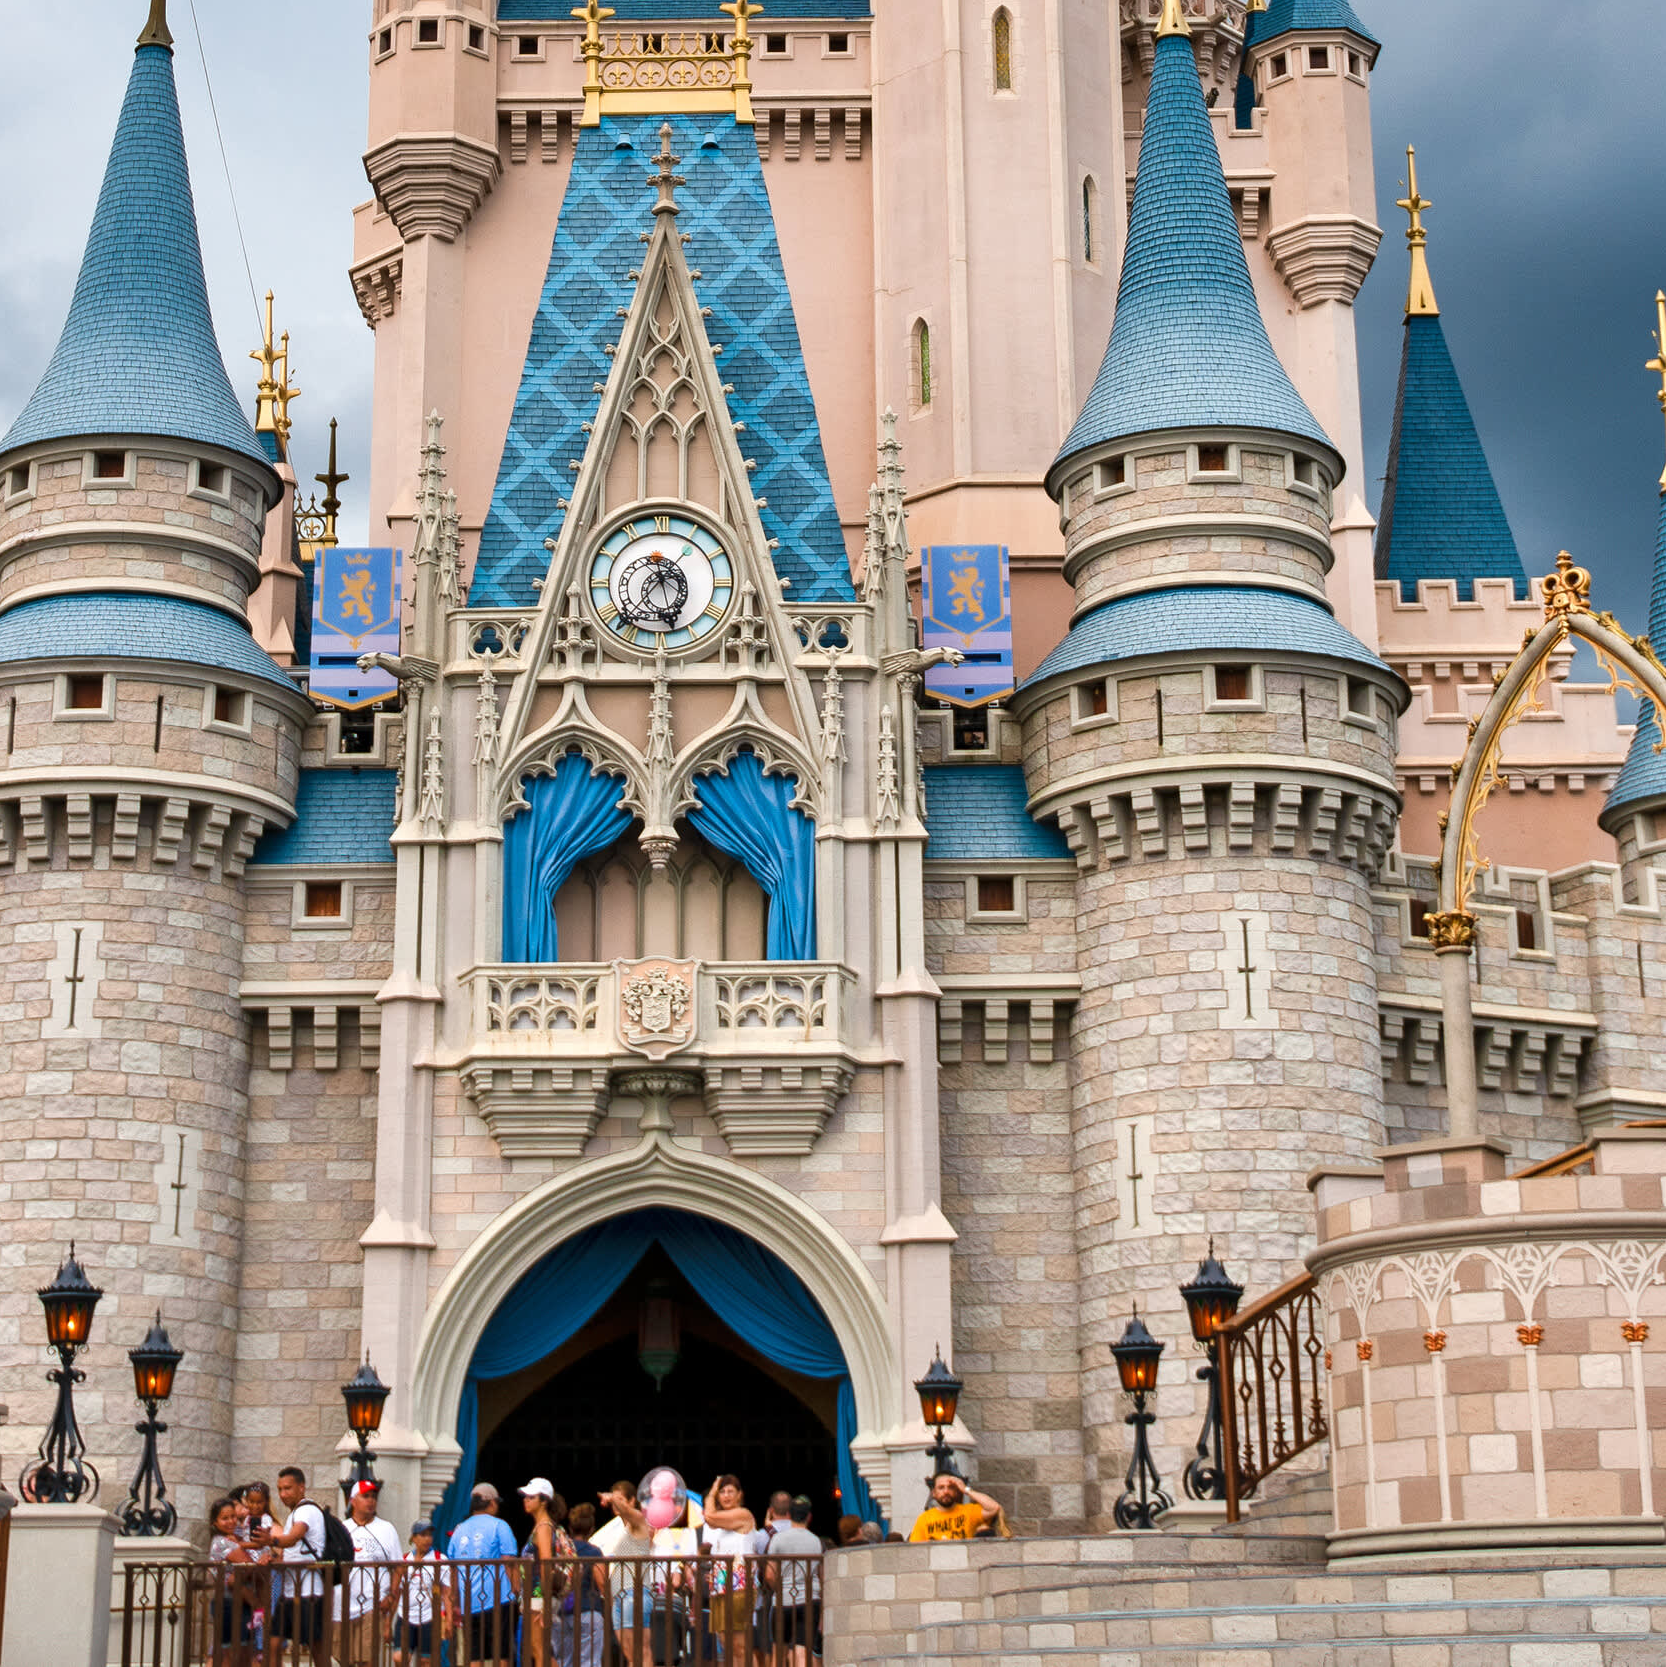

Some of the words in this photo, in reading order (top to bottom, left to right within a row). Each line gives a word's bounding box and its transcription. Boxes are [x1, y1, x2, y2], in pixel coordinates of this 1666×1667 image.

[622, 522, 640, 542] XI
[654, 516, 670, 533] XII
[688, 524, 698, 539] I
[598, 546, 617, 560] X
[708, 546, 724, 560] II
[591, 576, 609, 587] IX
[714, 577, 732, 587] III
[597, 601, 618, 624] VIII
[704, 601, 724, 621] IIII
[928, 1518, 952, 1534] WHAT
